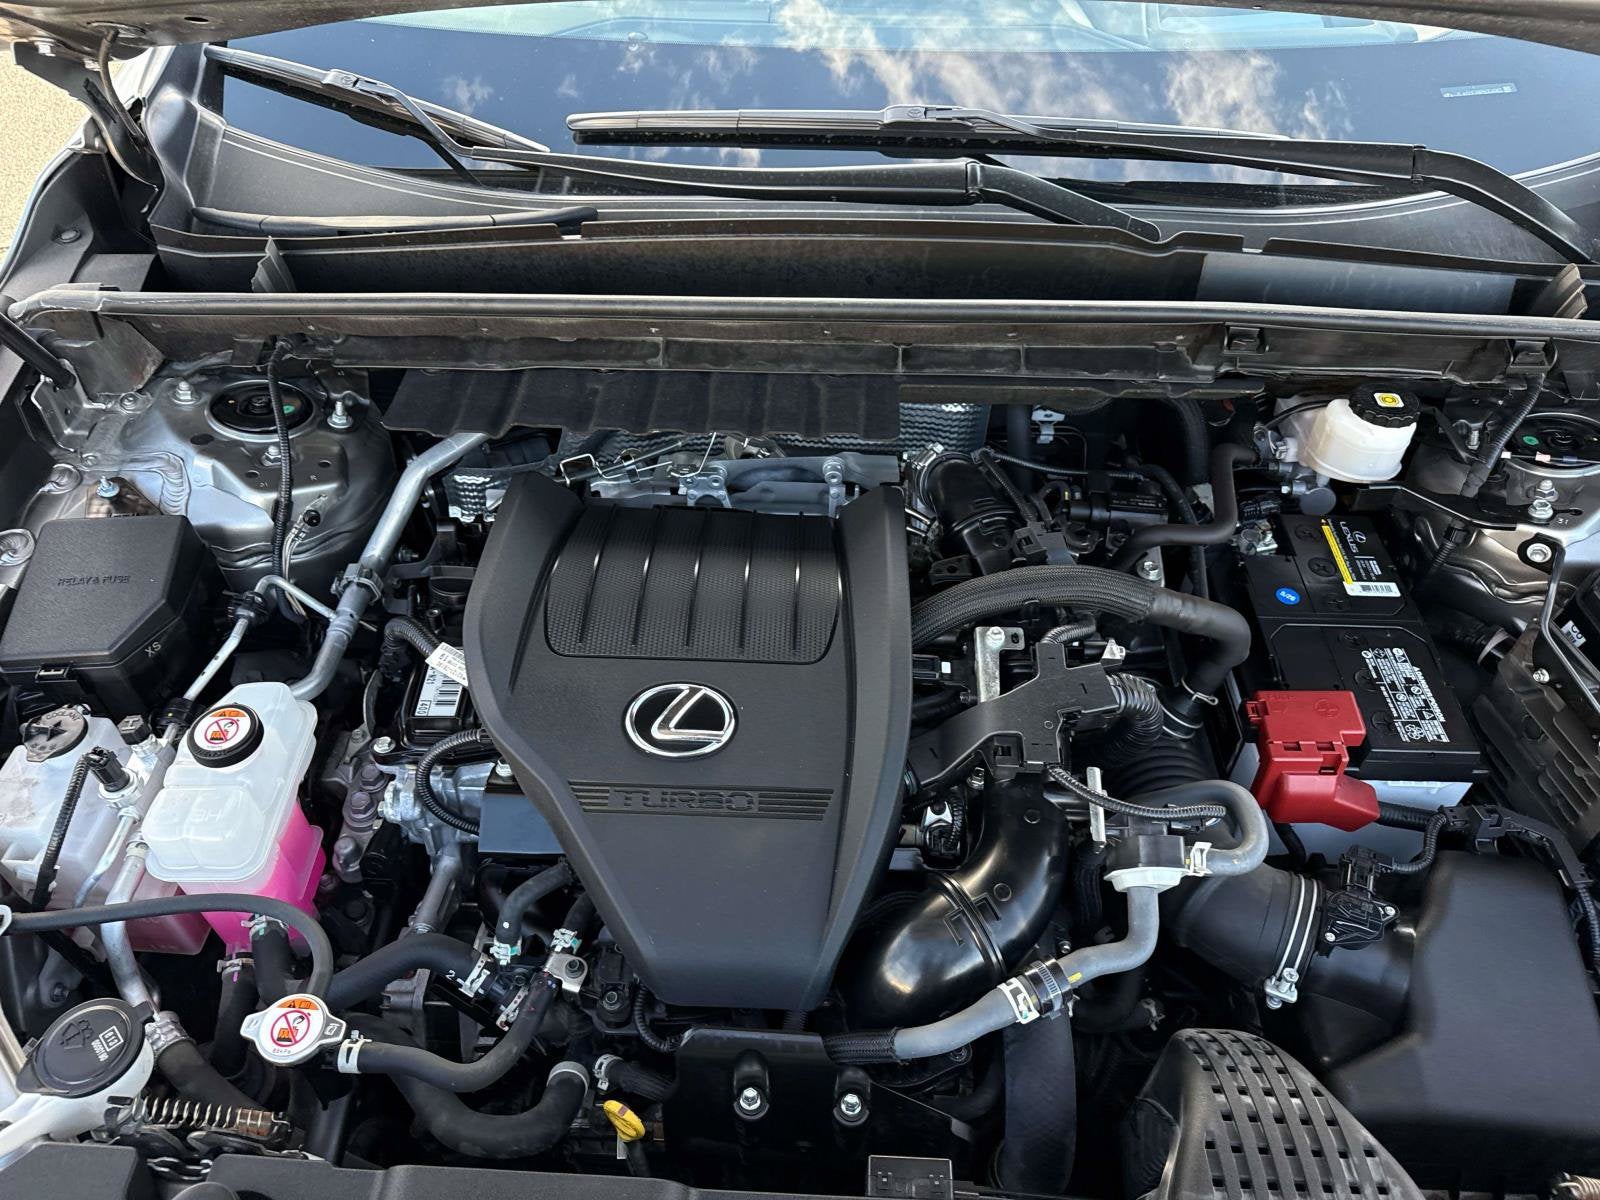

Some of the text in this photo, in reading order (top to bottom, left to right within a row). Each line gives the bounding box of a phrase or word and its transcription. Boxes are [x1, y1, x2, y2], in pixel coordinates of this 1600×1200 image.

[1340, 521, 1359, 553] LEXUS
[144, 641, 162, 658] XS
[613, 789, 754, 812] TURBO
